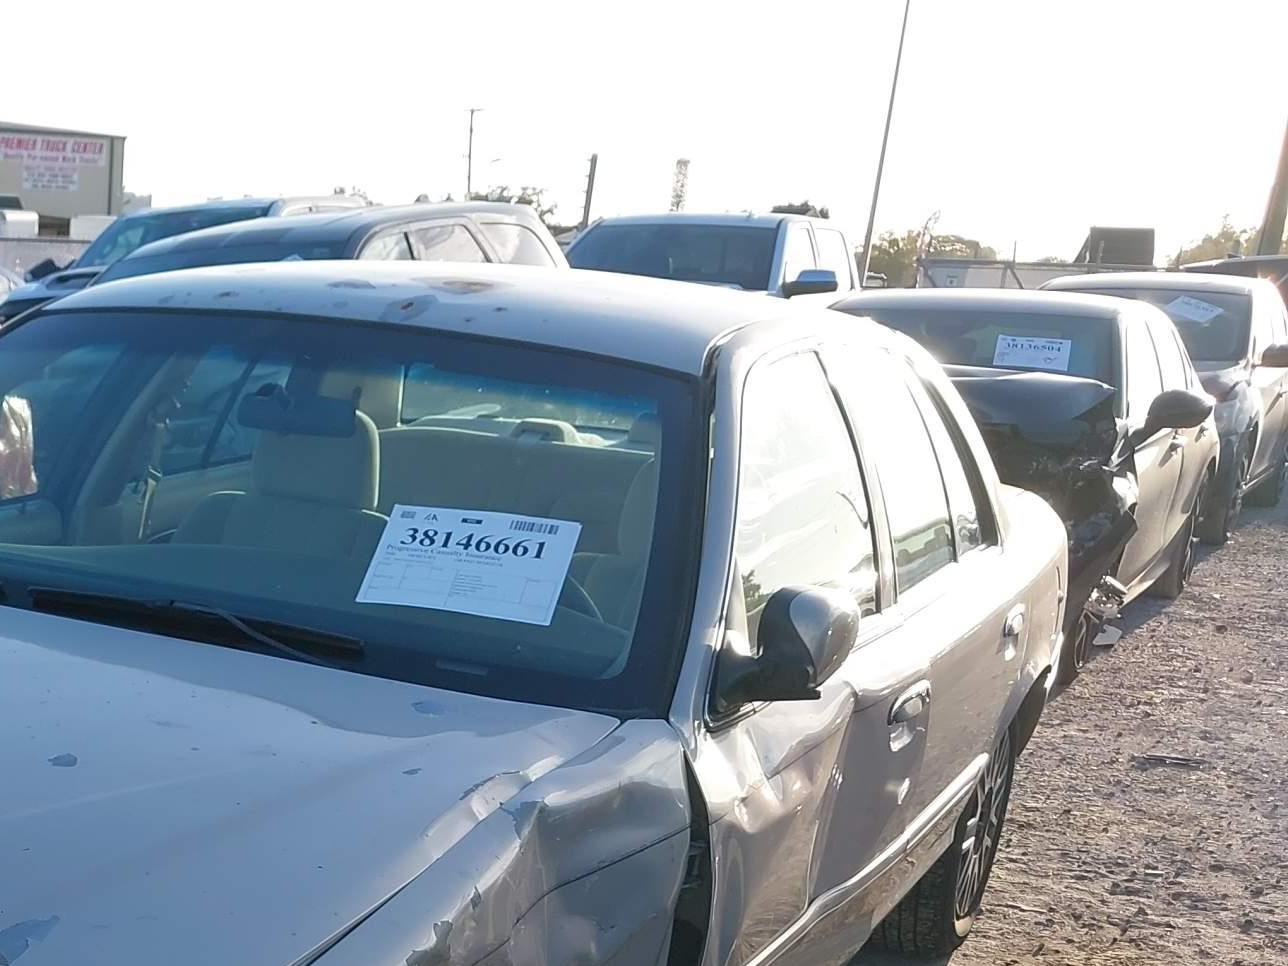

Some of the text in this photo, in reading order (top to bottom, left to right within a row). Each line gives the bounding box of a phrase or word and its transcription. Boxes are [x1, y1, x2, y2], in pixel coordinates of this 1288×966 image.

[0, 136, 104, 154] PREMIER TRUCK CENTER
[400, 527, 547, 560] 38146661
